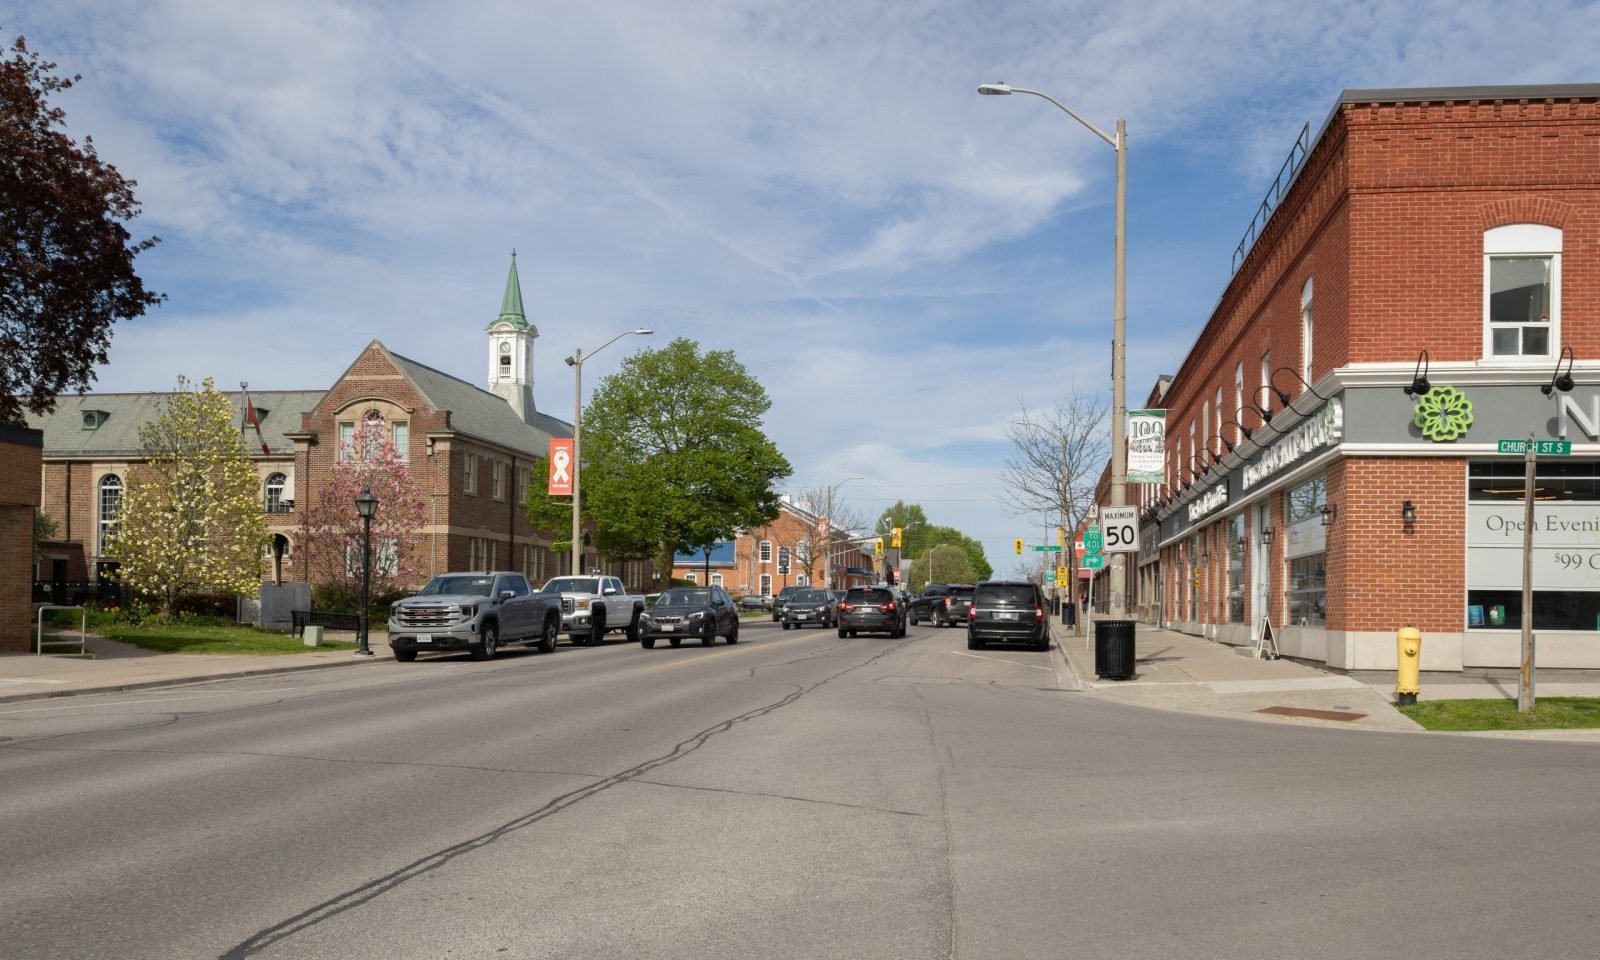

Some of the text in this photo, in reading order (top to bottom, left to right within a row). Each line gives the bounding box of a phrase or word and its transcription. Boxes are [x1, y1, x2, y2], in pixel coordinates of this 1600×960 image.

[1131, 421, 1164, 438] 100
[1501, 441, 1563, 453] CHURCH ST S
[1104, 511, 1134, 520] MAXIMUM
[1106, 525, 1134, 546] 50
[1086, 540, 1099, 548] 401
[1554, 552, 1582, 570] $99
